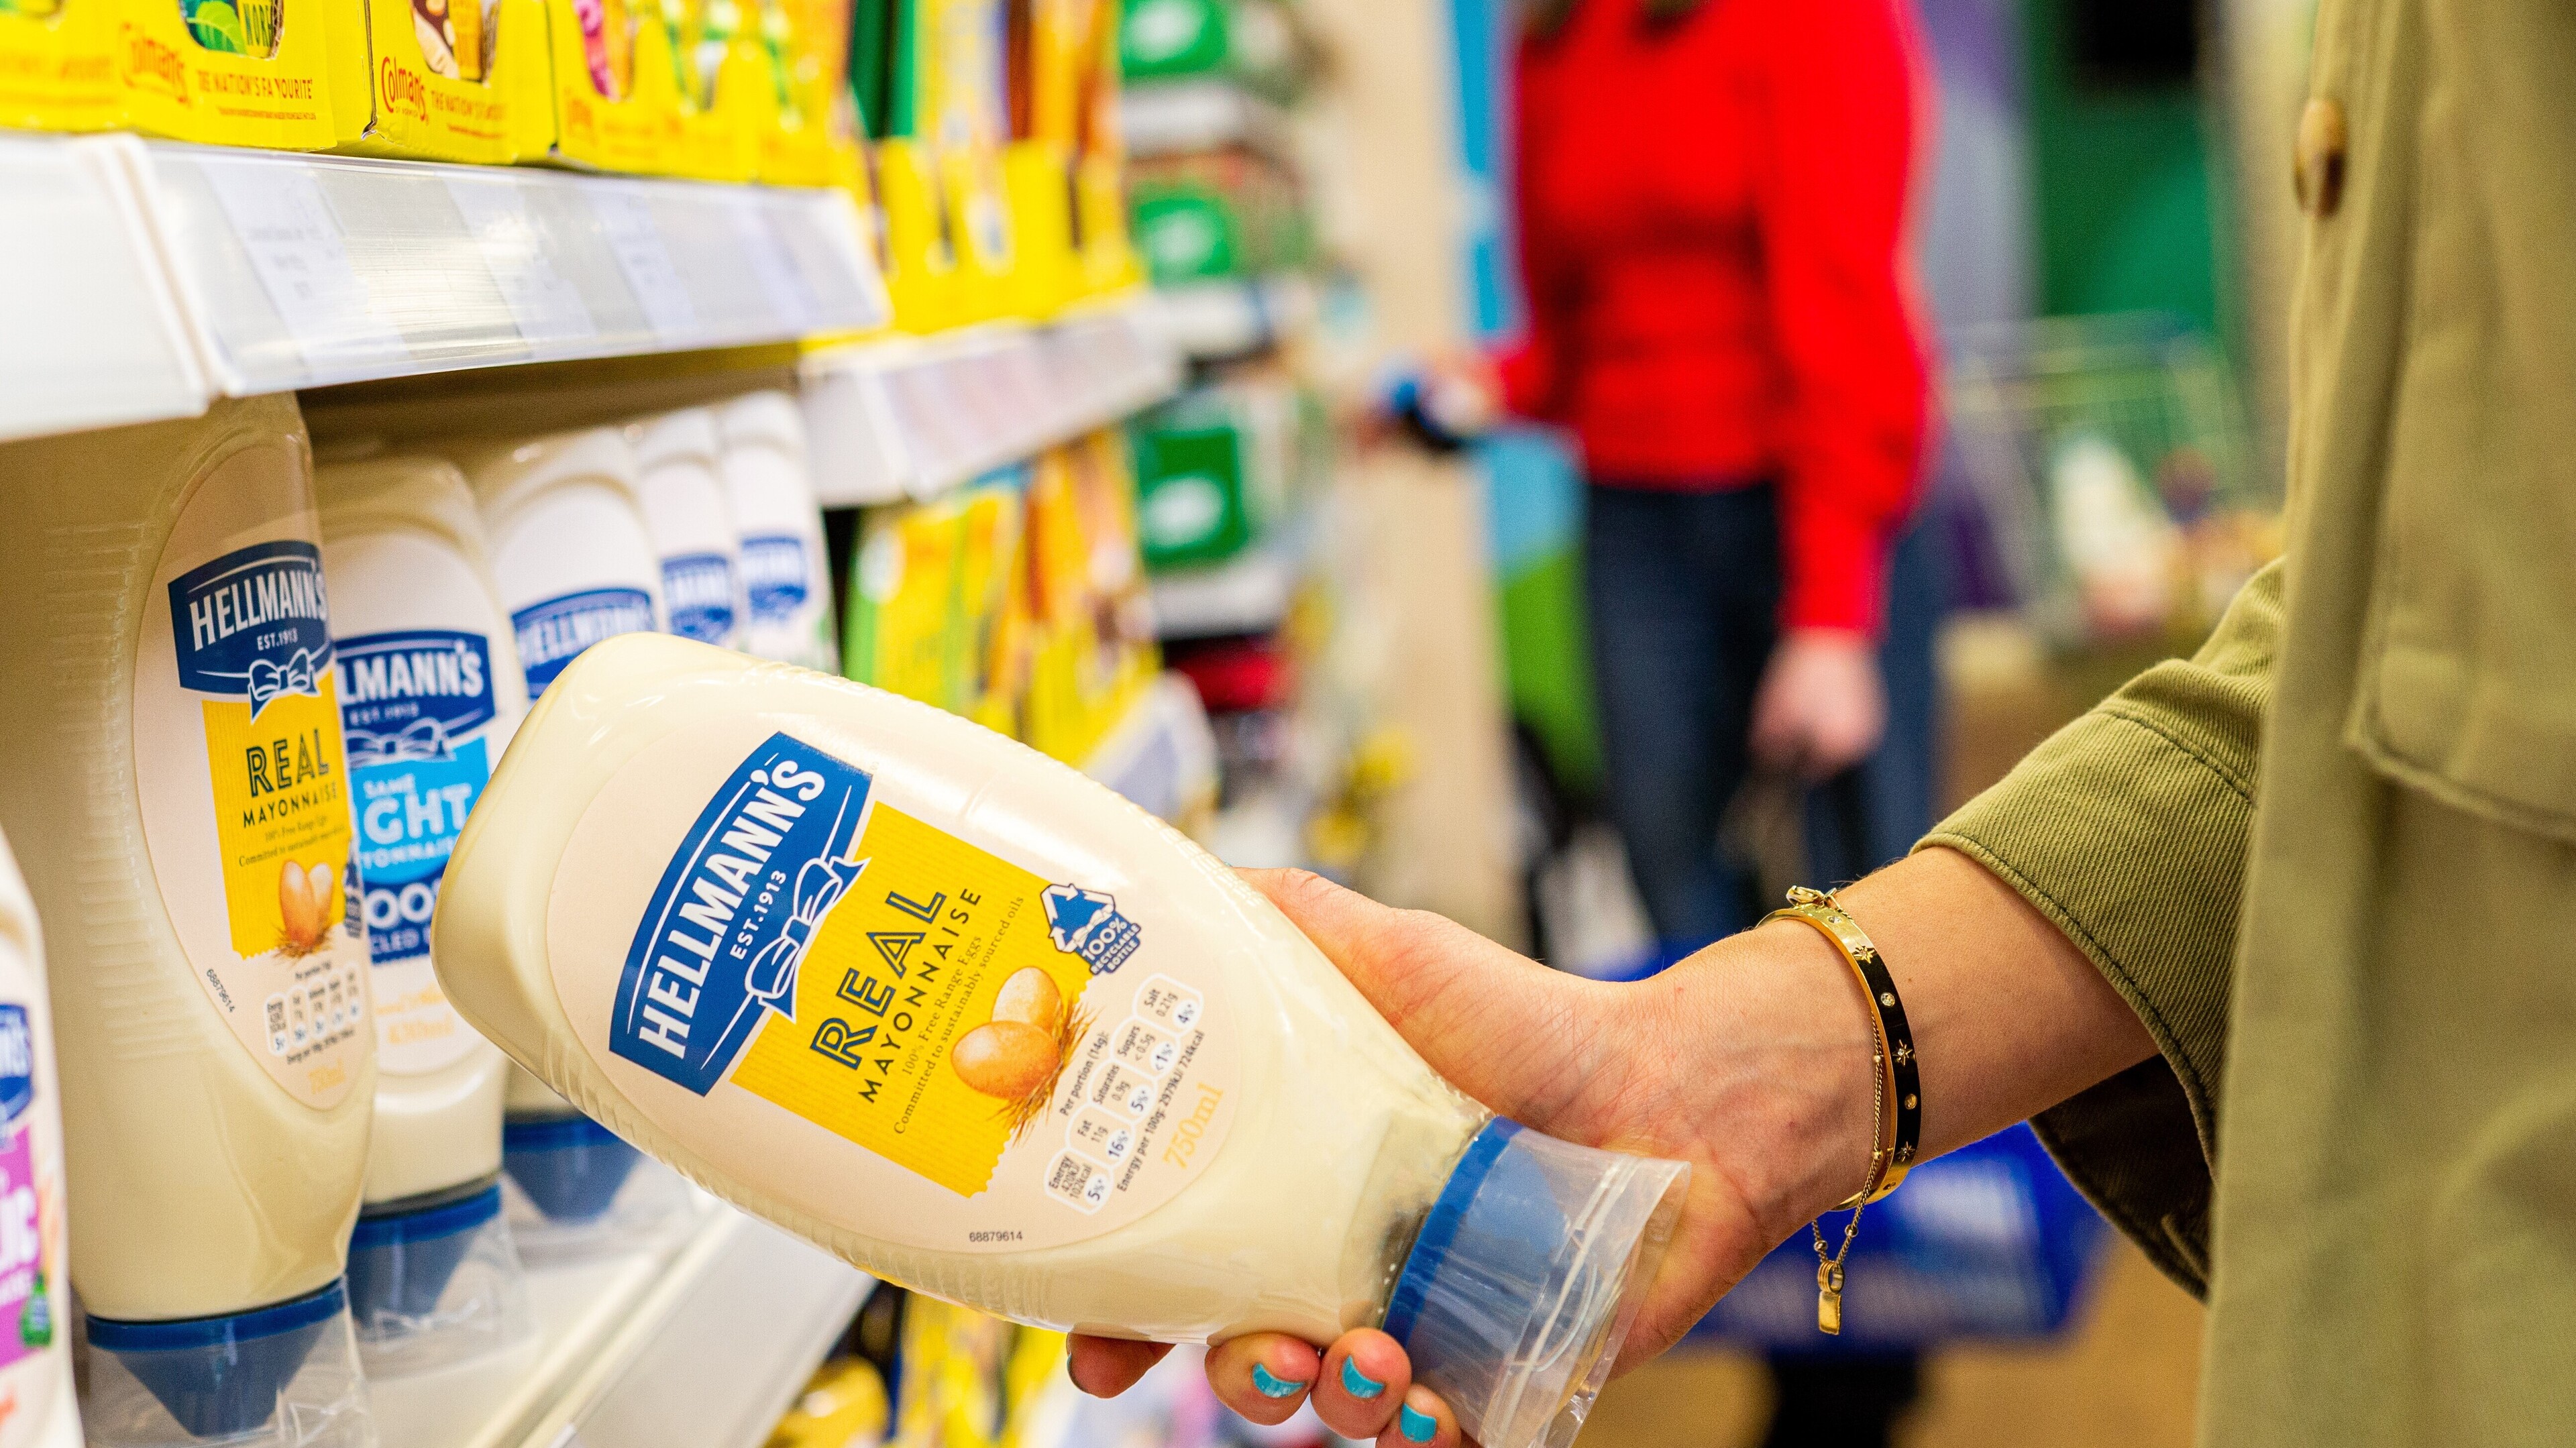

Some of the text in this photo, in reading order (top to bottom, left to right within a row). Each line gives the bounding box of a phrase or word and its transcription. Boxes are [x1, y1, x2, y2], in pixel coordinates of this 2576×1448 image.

[381, 56, 427, 121] Colman's
[189, 562, 327, 652] HELLMANN'S
[256, 628, 299, 651] EST.1913
[335, 639, 484, 705] LMANN'S
[246, 728, 330, 798] REAL
[243, 780, 339, 829] MAYONNAISE
[364, 783, 472, 845] GHT
[639, 759, 825, 1060] HELLMANN'S
[730, 870, 787, 960] EST.1913
[1082, 917, 1128, 961] 100%
[1090, 924, 1140, 974] RECYCLABLE
[1107, 940, 1138, 970] BOTTLE
[205, 968, 236, 1013] 68879614
[809, 891, 948, 1071] REAL
[858, 888, 982, 1104] MAYONNAISE
[902, 935, 982, 1076] 100% Free Range Eggs
[1143, 989, 1160, 1007] Salt
[1156, 993, 1178, 1017] 0.21g
[894, 895, 1025, 1135] Committed to sustainably sourced oils
[1117, 1025, 1140, 1056] Sugars
[1136, 1034, 1155, 1053] 0.5g
[1059, 1032, 1108, 1116] Per portion (14g):
[1092, 1065, 1119, 1104] Saturates
[1111, 1081, 1130, 1101] 0.9g
[1077, 1120, 1091, 1136] Fat
[1090, 1126, 1108, 1142] 11g
[1116, 1156, 1142, 1191] Energy
[1136, 1136, 1148, 1156] per
[1144, 1108, 1165, 1133] 100g:
[1177, 1029, 1203, 1068] 724kcal
[1163, 1082, 1224, 1169] 750ml
[1048, 1156, 1073, 1188] Energy
[1069, 1164, 1091, 1197] 102kcal
[969, 1231, 1022, 1242] 68879614
